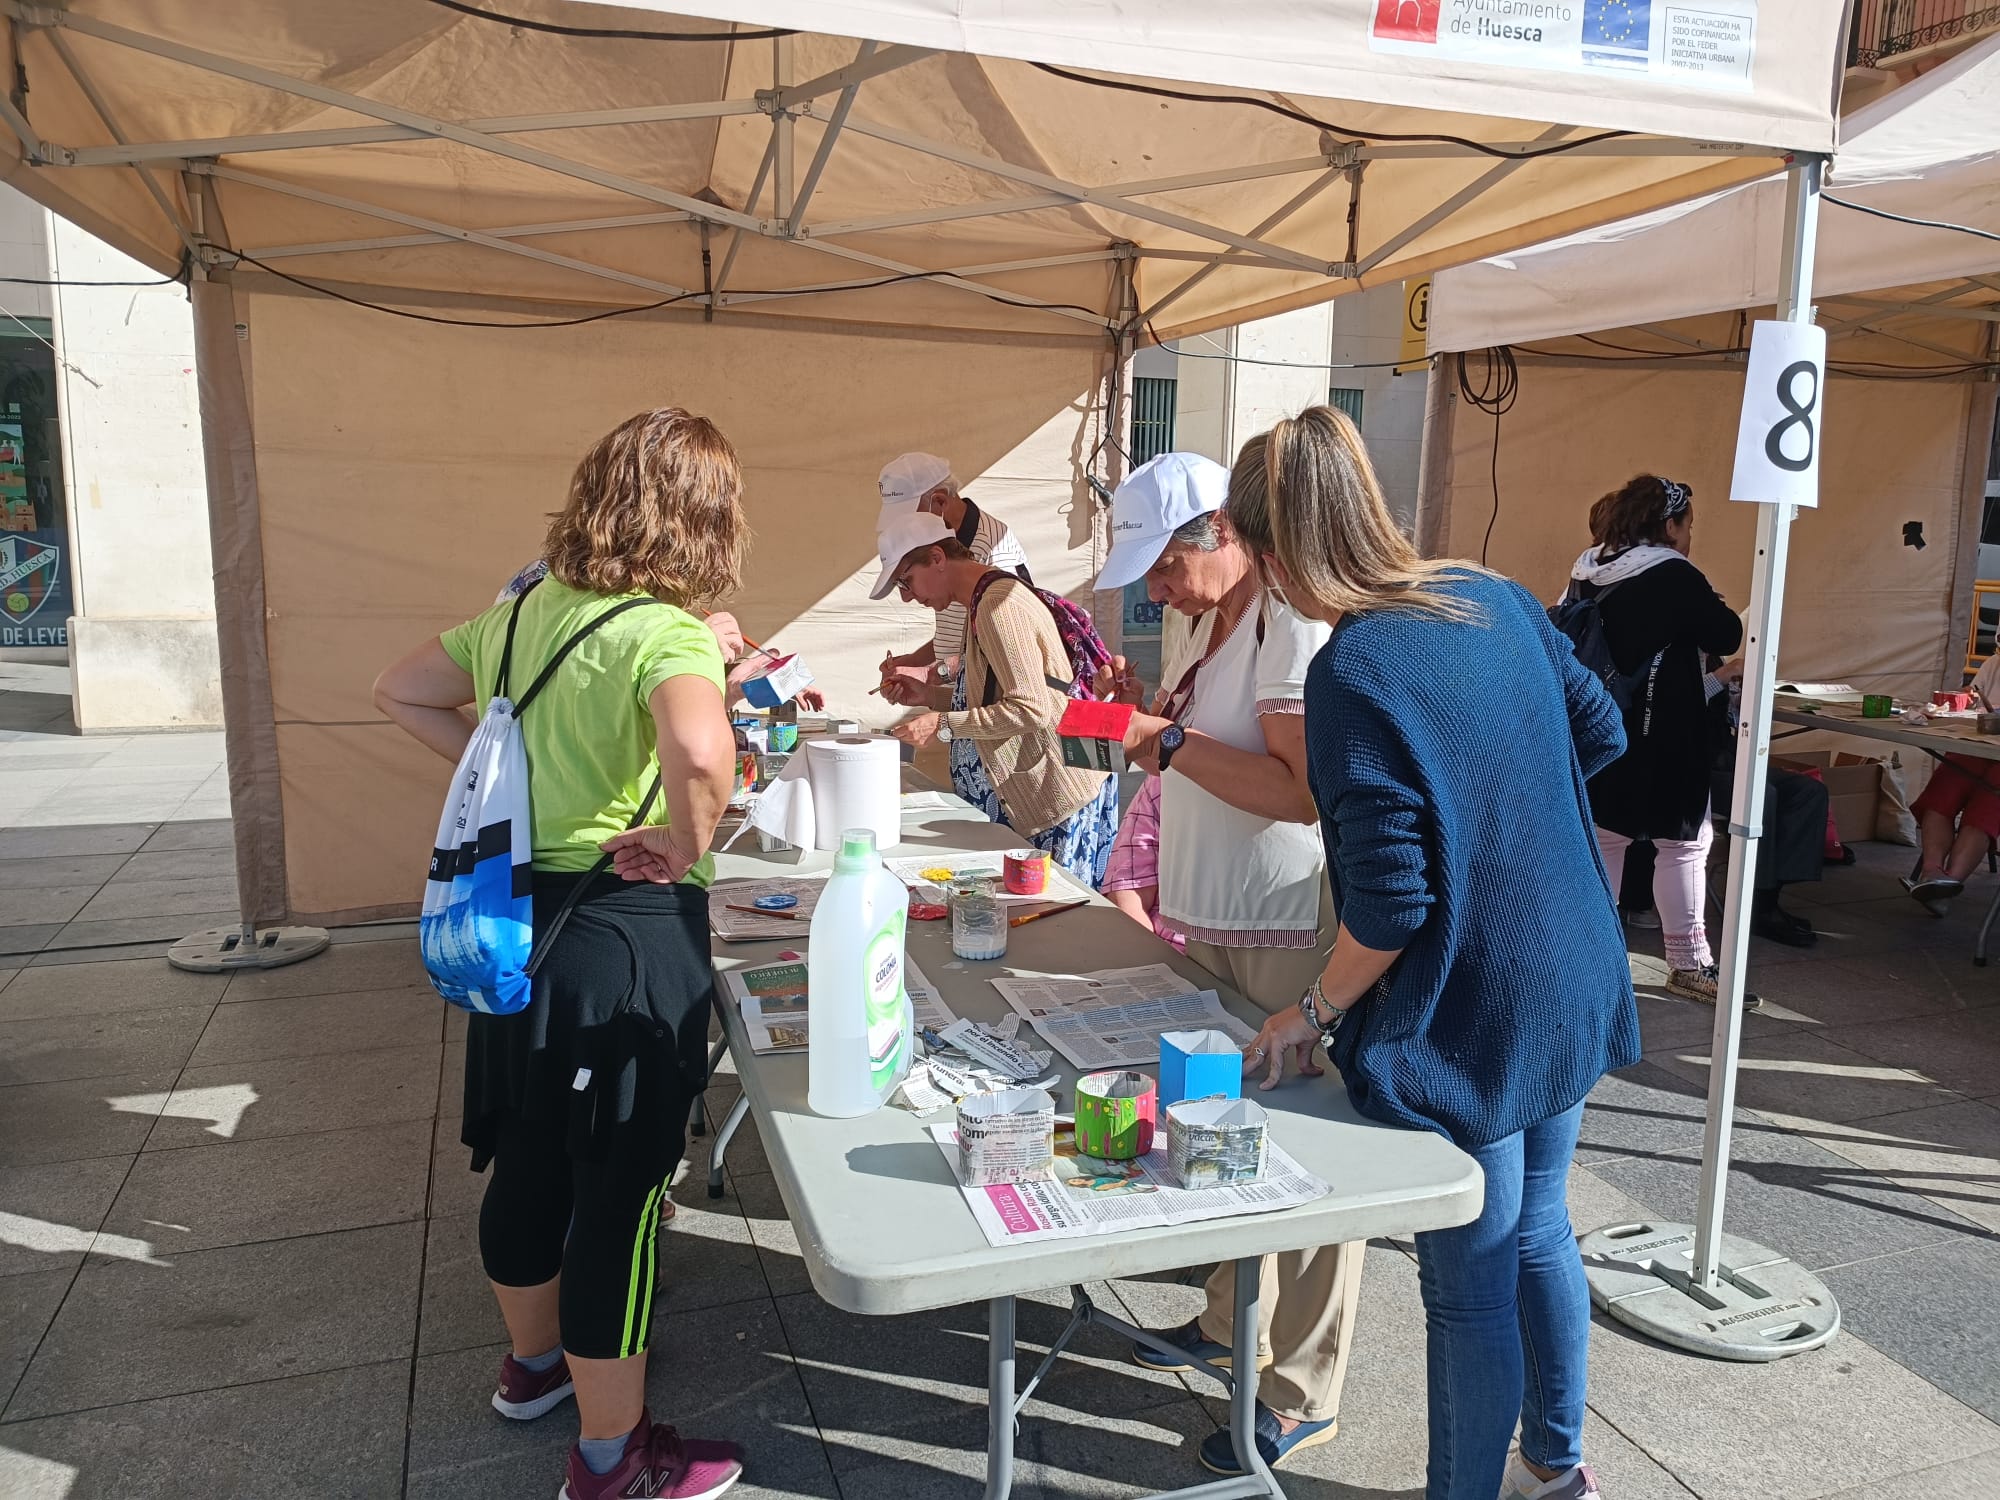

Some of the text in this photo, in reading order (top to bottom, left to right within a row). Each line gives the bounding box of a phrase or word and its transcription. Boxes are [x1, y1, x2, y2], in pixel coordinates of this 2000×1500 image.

[1451, 15, 1542, 42] de Huesca
[1673, 15, 1690, 24] ESTA
[1731, 23, 1741, 31] HA
[1672, 26, 1740, 42] SIDO COFINANCIADA
[1672, 37, 1718, 50] POR EL FEDER
[1671, 48, 1736, 64] INICIATIVA URBANA
[1764, 360, 1818, 472] 8
[10, 552, 52, 580] HUESCA
[3, 627, 24, 645] DE
[1648, 666, 1658, 681] THE
[1646, 682, 1654, 701] LOVE
[964, 1026, 980, 1040] por
[980, 1036, 988, 1044] el
[986, 1039, 1019, 1064] incendio
[1023, 1191, 1038, 1207] Raro
[1035, 1189, 1052, 1205] idilio
[1029, 1206, 1053, 1231] Rosario
[1046, 1204, 1063, 1221] largo
[1054, 1220, 1067, 1229] su
